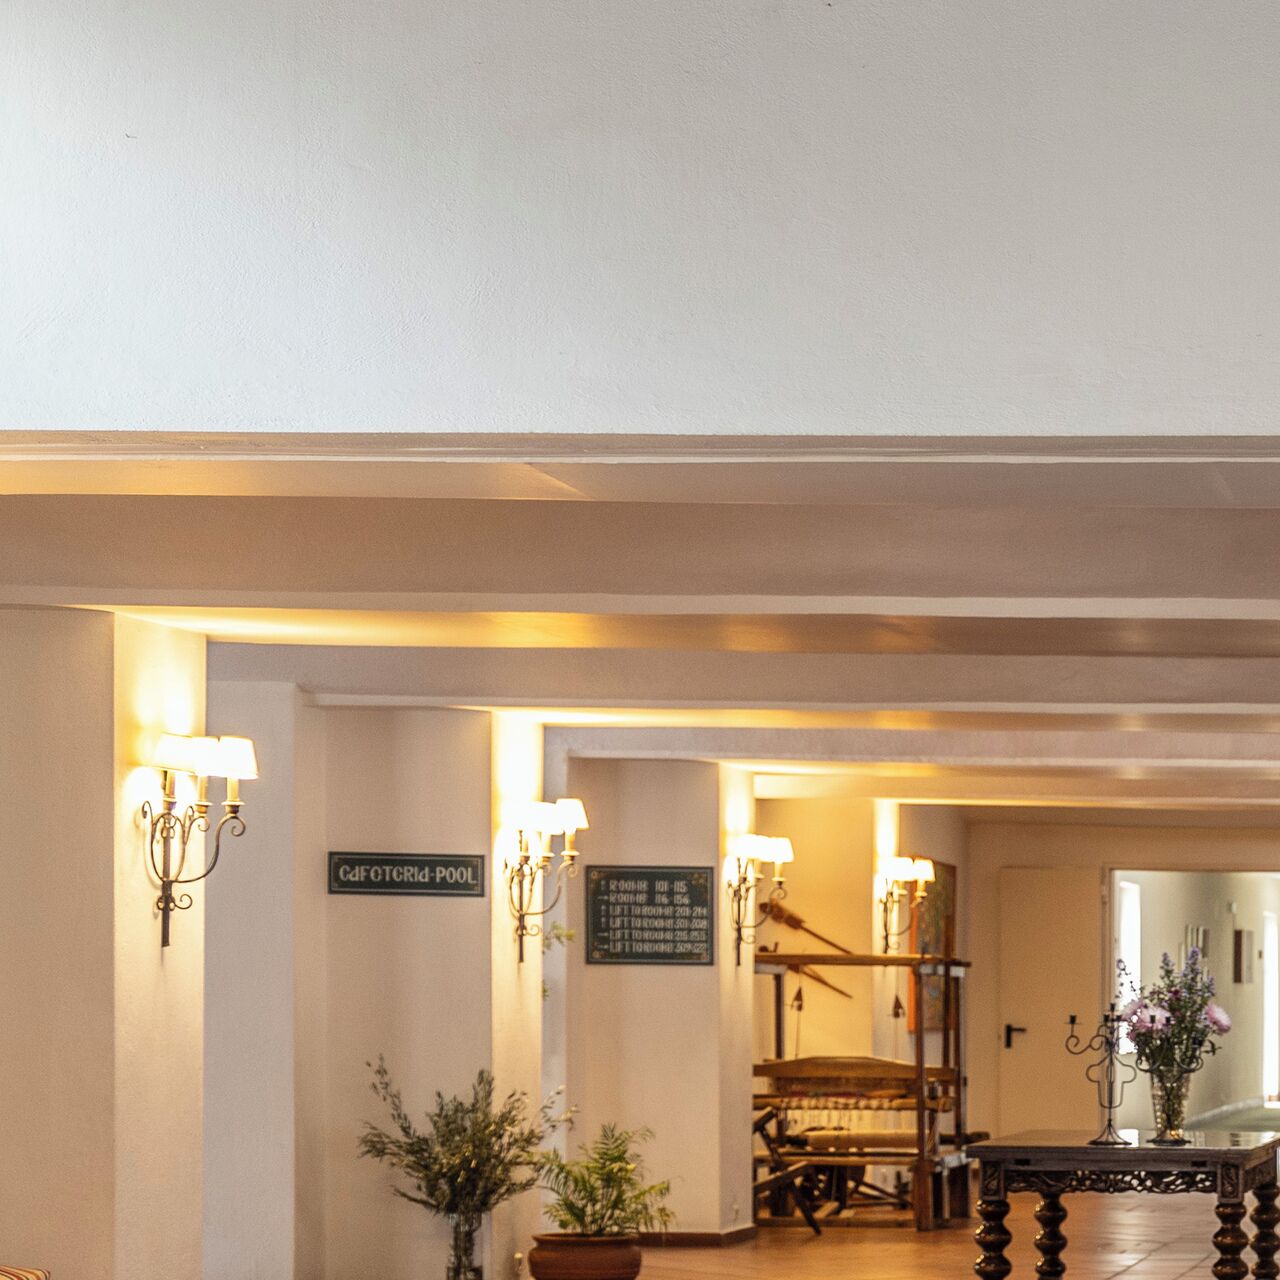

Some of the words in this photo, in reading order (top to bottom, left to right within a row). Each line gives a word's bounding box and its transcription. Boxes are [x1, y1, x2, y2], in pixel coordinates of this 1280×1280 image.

[609, 880, 648, 892] ROOMS
[609, 893, 648, 904] ROOMS
[609, 905, 629, 917] LIFT
[631, 905, 641, 917] TO
[609, 917, 629, 929] LIFT
[631, 917, 641, 929] TO
[609, 929, 629, 941] LIFT
[632, 929, 642, 941] TO
[609, 941, 629, 953] LIFT
[632, 941, 643, 953] TO
